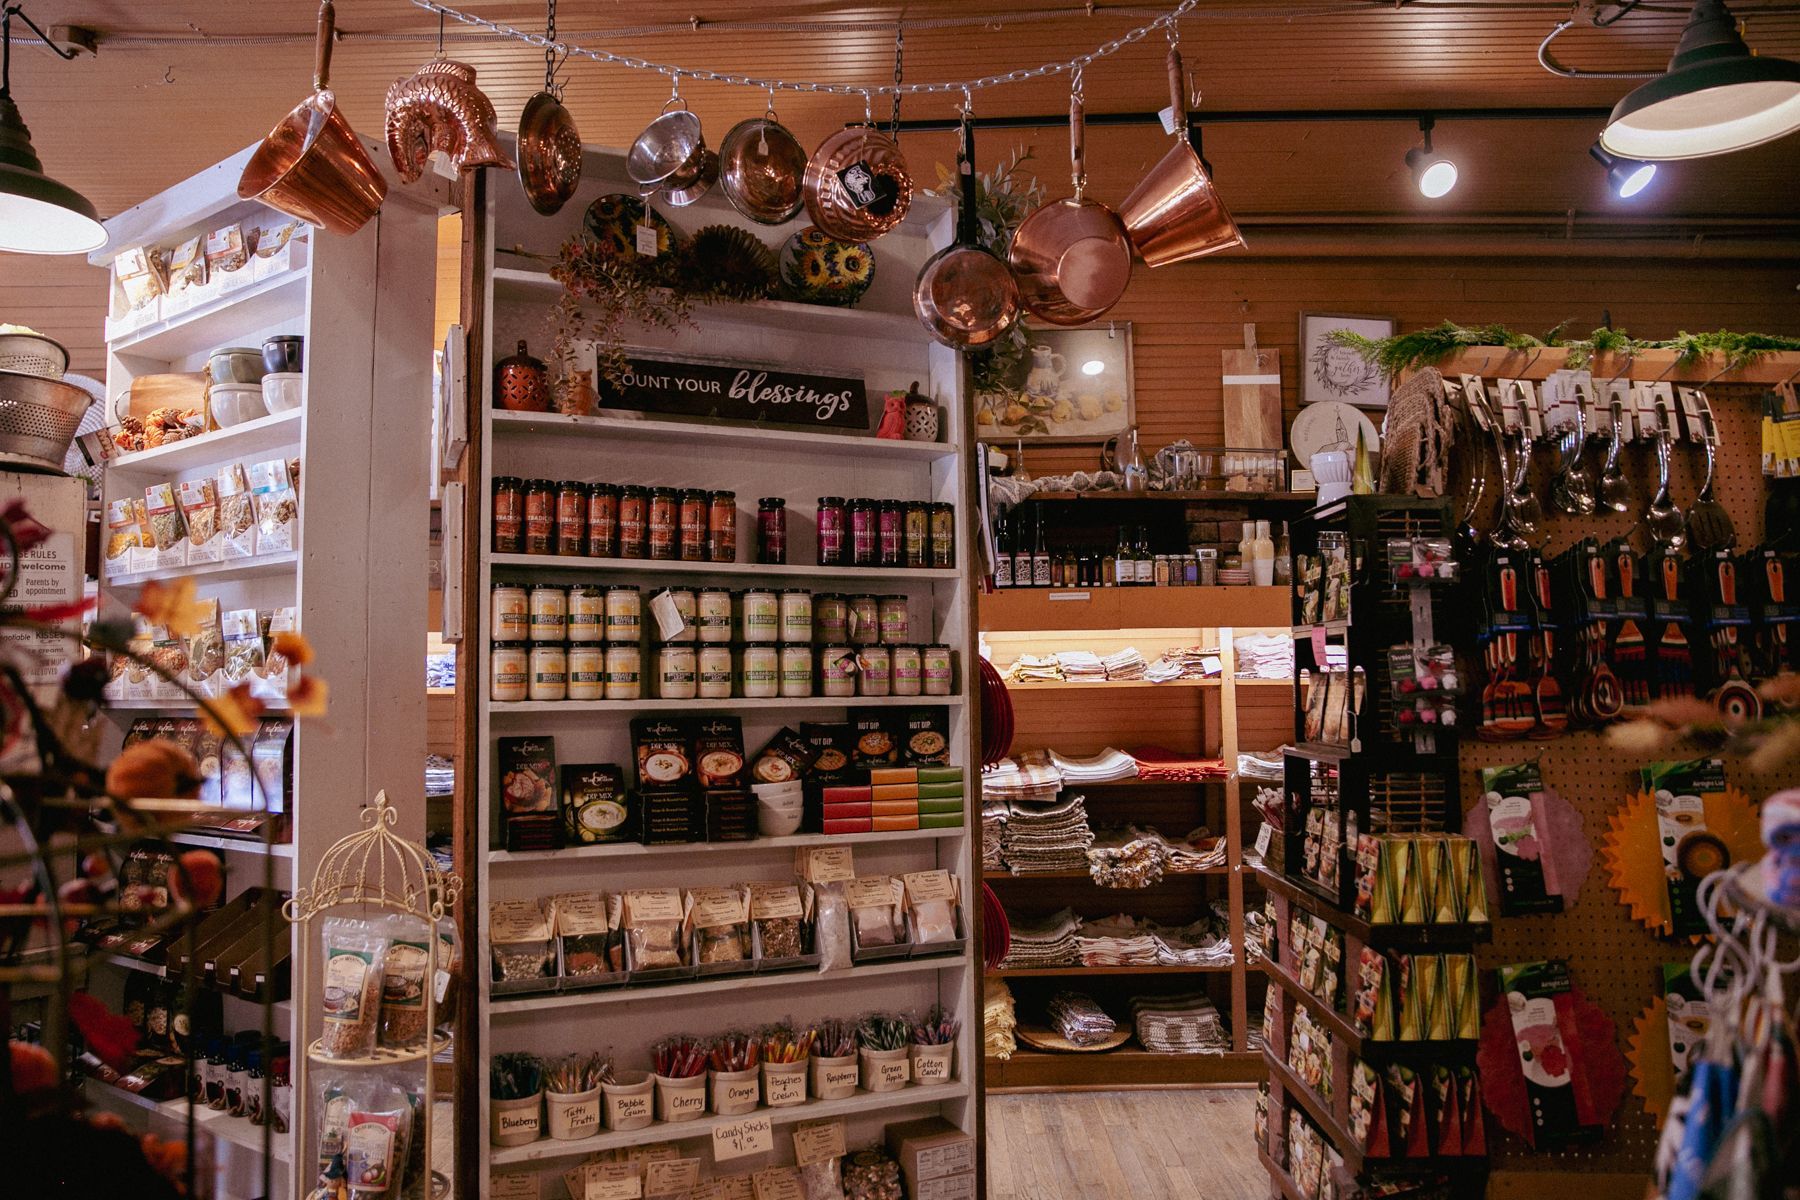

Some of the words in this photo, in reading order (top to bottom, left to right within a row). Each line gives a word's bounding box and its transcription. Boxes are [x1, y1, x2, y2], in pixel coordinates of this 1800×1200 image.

[619, 372, 671, 391] OUNT
[674, 377, 722, 395] YOUR
[728, 370, 853, 420] blessings
[30, 550, 57, 559] RULES
[21, 562, 66, 571] welcome
[25, 578, 50, 586] Parents
[51, 578, 60, 587] by
[25, 587, 66, 596] appointment
[857, 722, 870, 730] HOT
[909, 721, 920, 729] HOT
[921, 721, 931, 729] DIP
[916, 1058, 944, 1069] Cotton
[881, 1064, 902, 1074] Green
[771, 1076, 802, 1086] Peaches
[826, 1071, 857, 1084] Raspberry
[885, 1073, 905, 1083] Apple
[728, 1087, 755, 1100] Orange
[771, 1091, 799, 1101] Cream
[618, 1099, 645, 1109] Bubble
[672, 1096, 703, 1112] Cherry
[563, 1106, 587, 1118] Tutti
[623, 1108, 647, 1118] Gum
[501, 1117, 538, 1129] Blueberry
[570, 1114, 596, 1128] Frutti
[715, 1127, 744, 1141] Candy
[743, 1120, 770, 1134] Sticks
